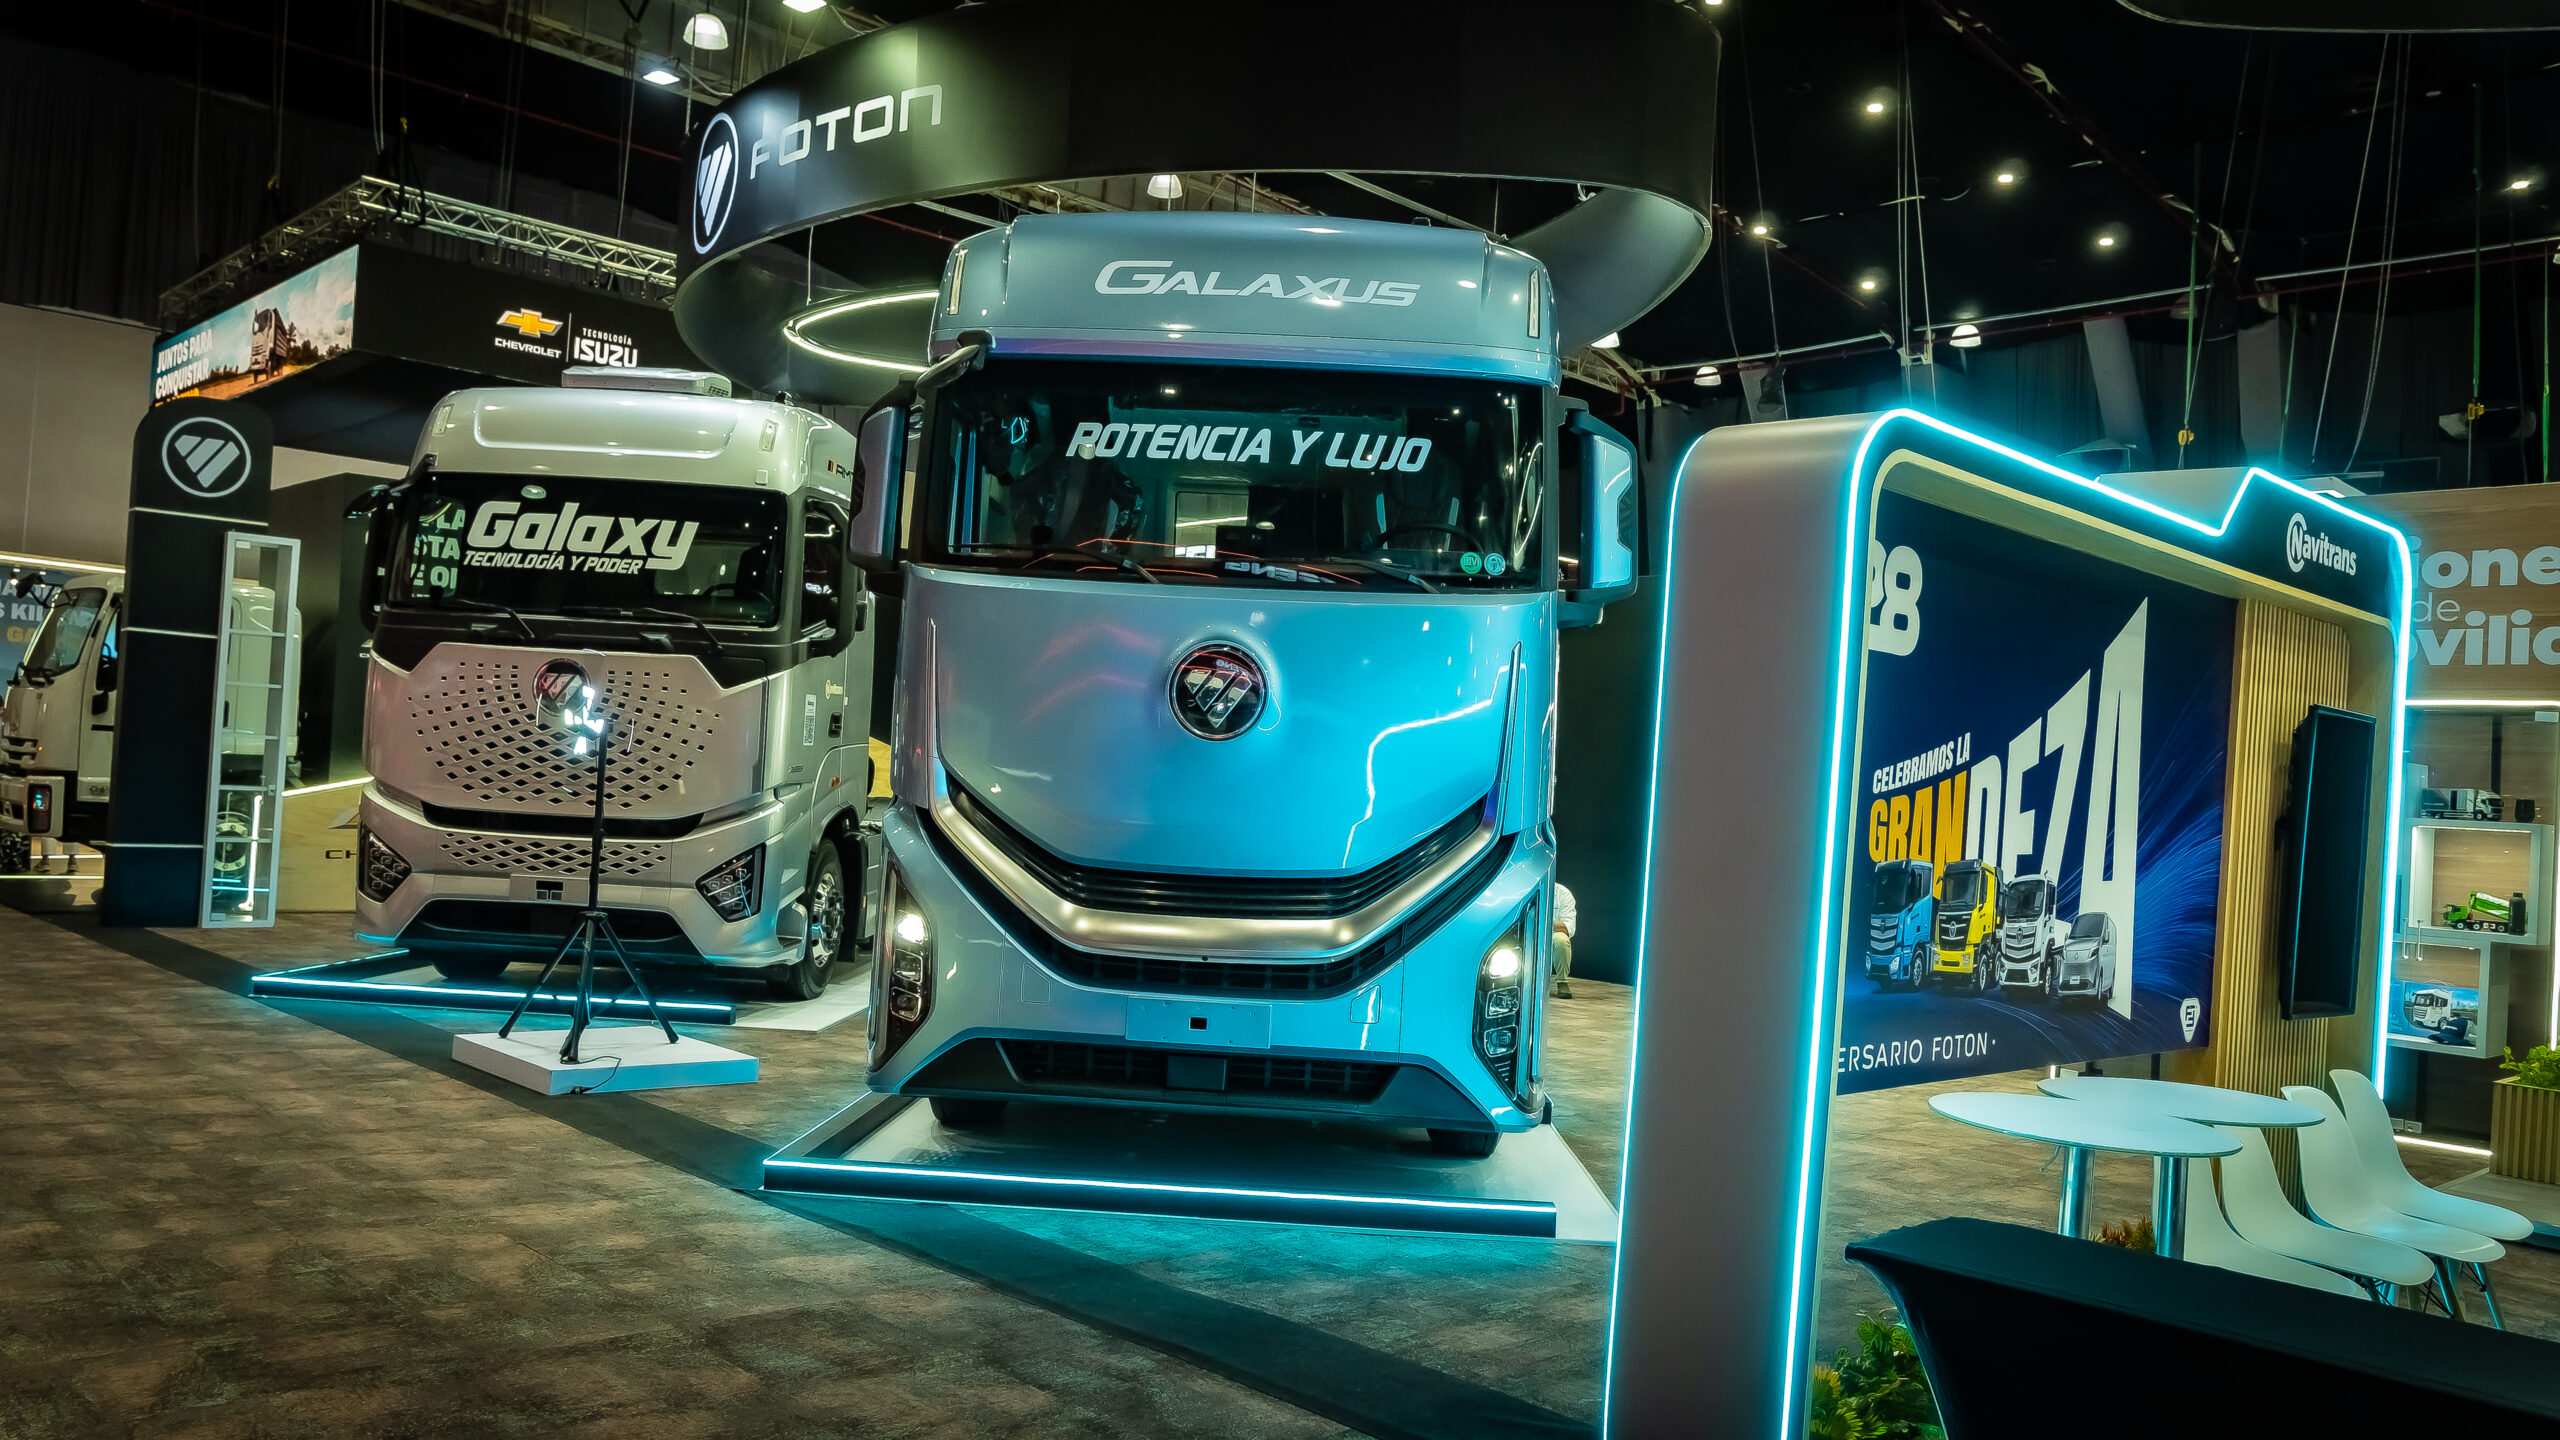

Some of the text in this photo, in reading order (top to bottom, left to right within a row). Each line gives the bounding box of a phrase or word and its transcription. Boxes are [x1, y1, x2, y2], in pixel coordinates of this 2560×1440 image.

[750, 84, 943, 181] FOTON
[156, 328, 213, 374] JUNTOS PARA
[494, 337, 562, 359] CHEVROLET
[573, 336, 638, 368] ISUZU
[155, 357, 210, 400] CONQUISTAR
[1290, 430, 1323, 465] Y
[1325, 434, 1432, 472] LUJO
[466, 500, 700, 571] Galaxy
[2286, 512, 2357, 576] Navitrans
[462, 550, 644, 575] TECNOLOGÍA Y PODER
[1872, 731, 1971, 794] CELEBRAMOS LA
[1868, 596, 2148, 1020] GRANDEZA
[1931, 1031, 1989, 1062] FOTON
